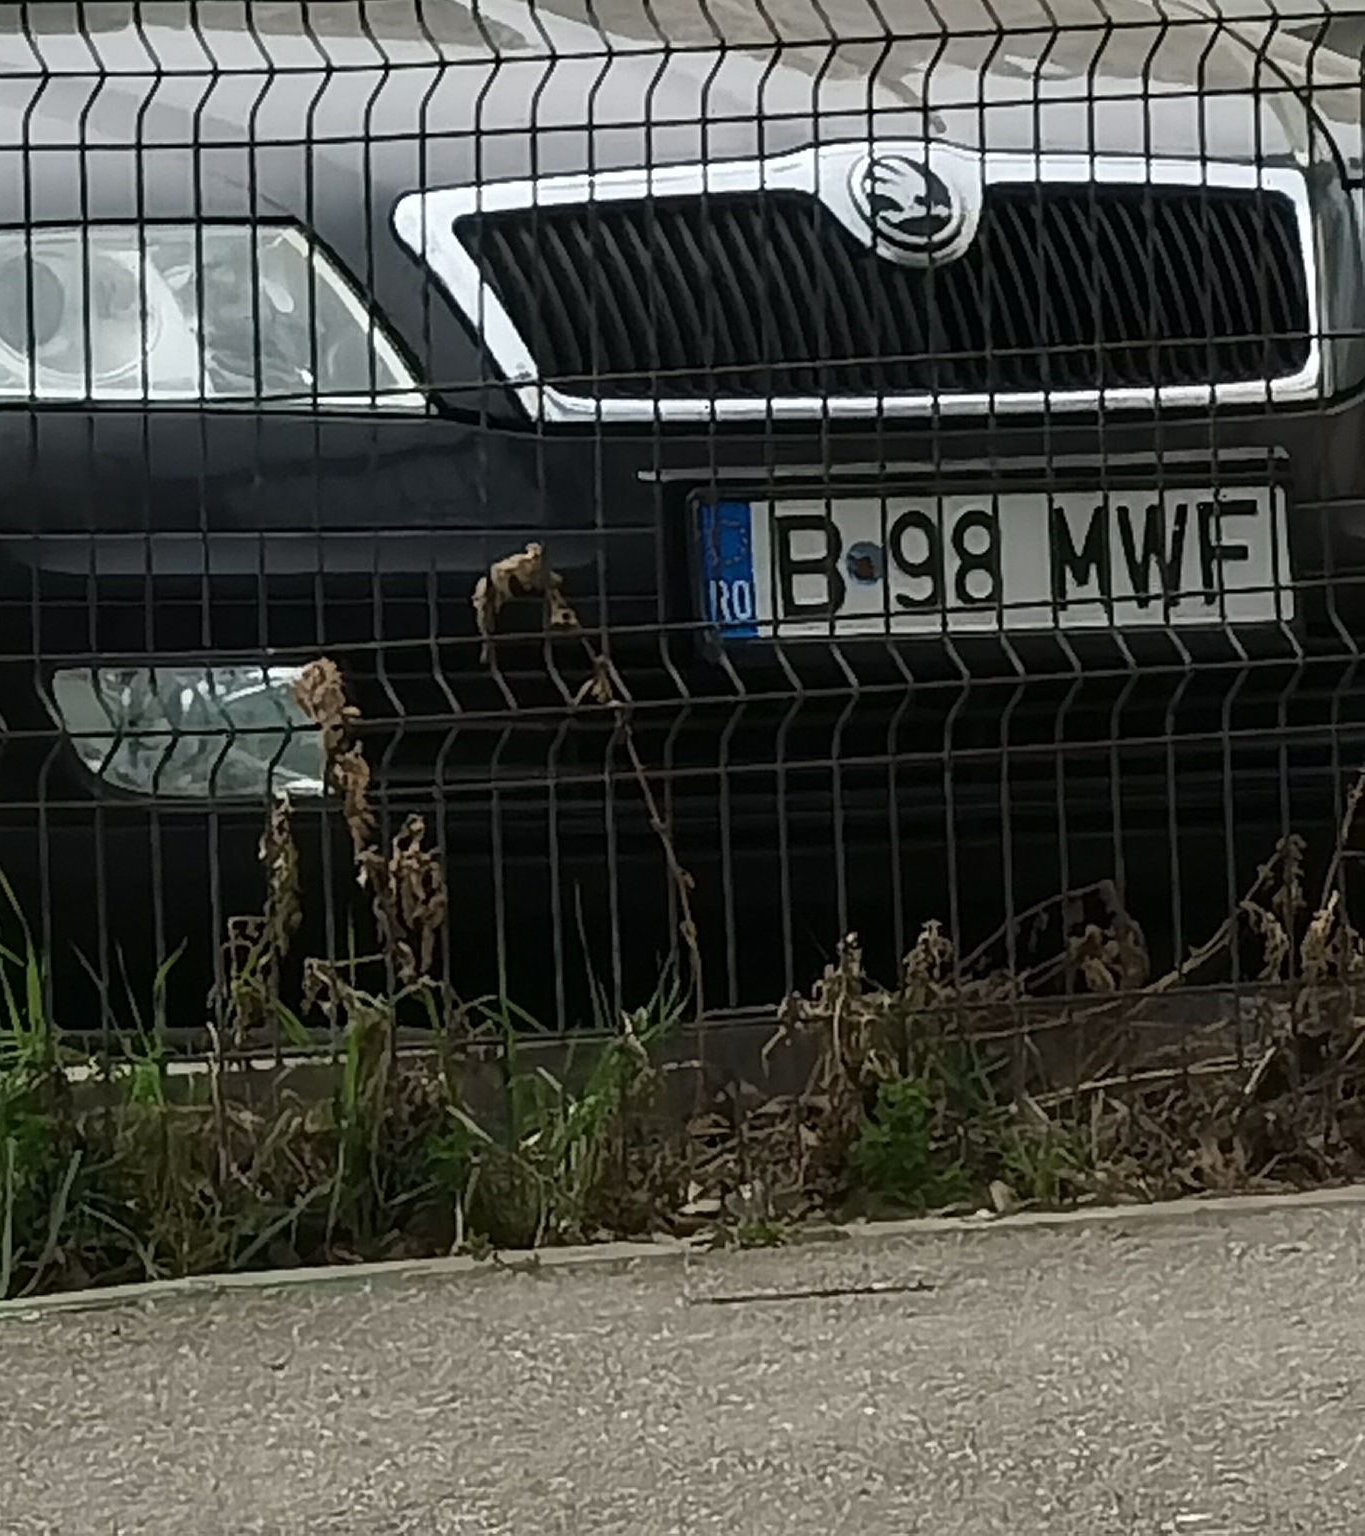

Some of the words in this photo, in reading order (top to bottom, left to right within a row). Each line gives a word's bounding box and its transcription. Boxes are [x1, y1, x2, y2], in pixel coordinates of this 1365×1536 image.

[772, 515, 842, 618] B
[890, 509, 1002, 609] 98
[1052, 499, 1259, 613] MWF
[710, 579, 752, 624] RO
